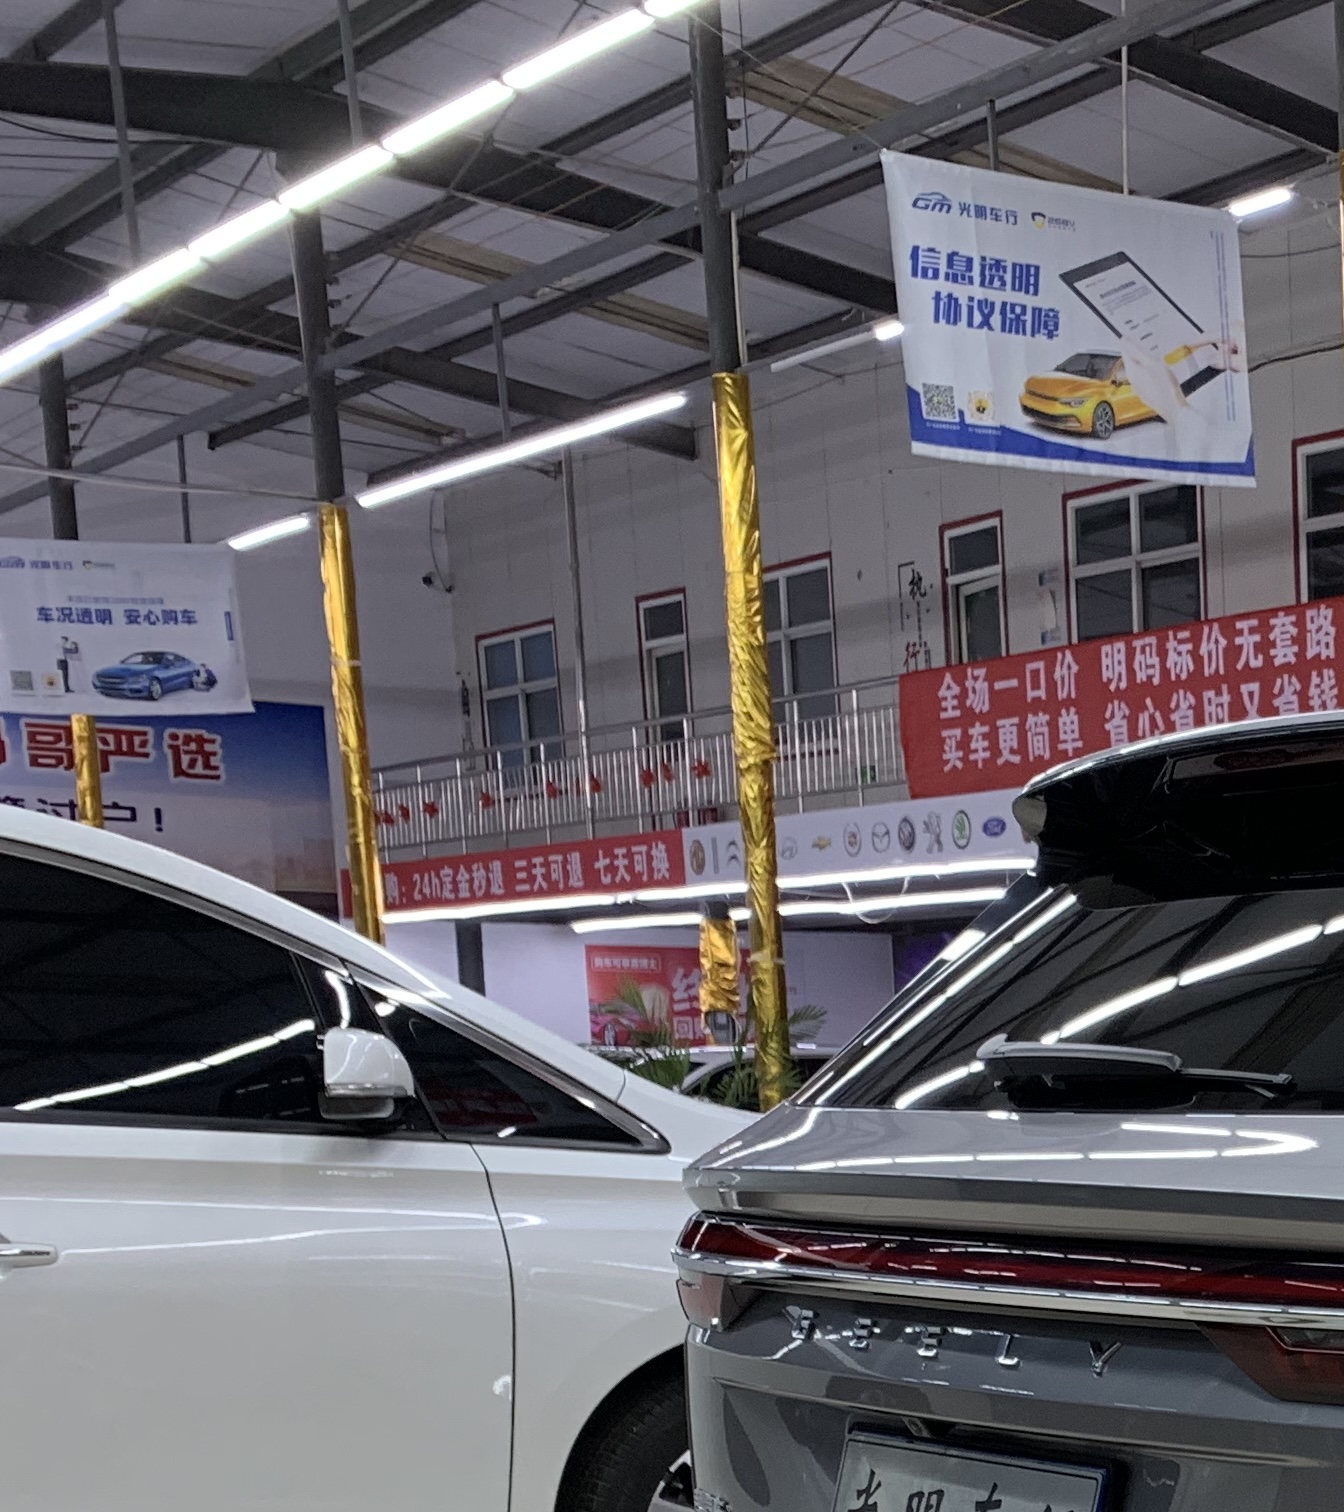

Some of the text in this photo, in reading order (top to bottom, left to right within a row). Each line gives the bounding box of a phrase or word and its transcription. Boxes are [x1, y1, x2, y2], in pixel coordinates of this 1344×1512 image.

[958, 202, 1018, 226] 光明车行
[909, 244, 1041, 297] 信息透明
[932, 290, 1061, 341] 协议保障
[937, 603, 1338, 720] 全场一口价 明码标价无套路
[941, 667, 1339, 773] 买车更简单 省心省时又省钱
[0, 722, 221, 781] 哥严选
[514, 851, 585, 893] 三天可退
[594, 840, 671, 885] 七天可换
